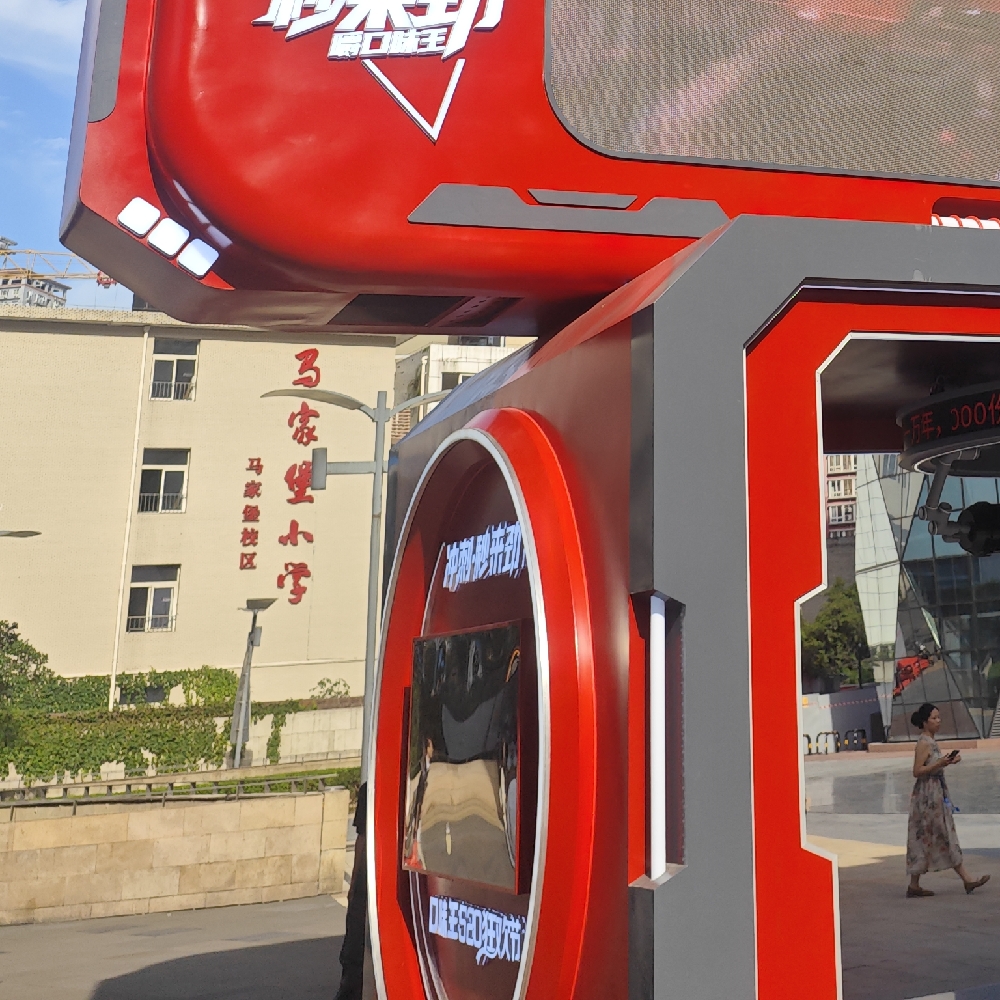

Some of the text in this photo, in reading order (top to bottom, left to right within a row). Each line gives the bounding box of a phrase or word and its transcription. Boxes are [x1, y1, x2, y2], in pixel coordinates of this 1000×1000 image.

[240, 457, 264, 570] 马家堡校区
[277, 348, 320, 605] 马家堡小学
